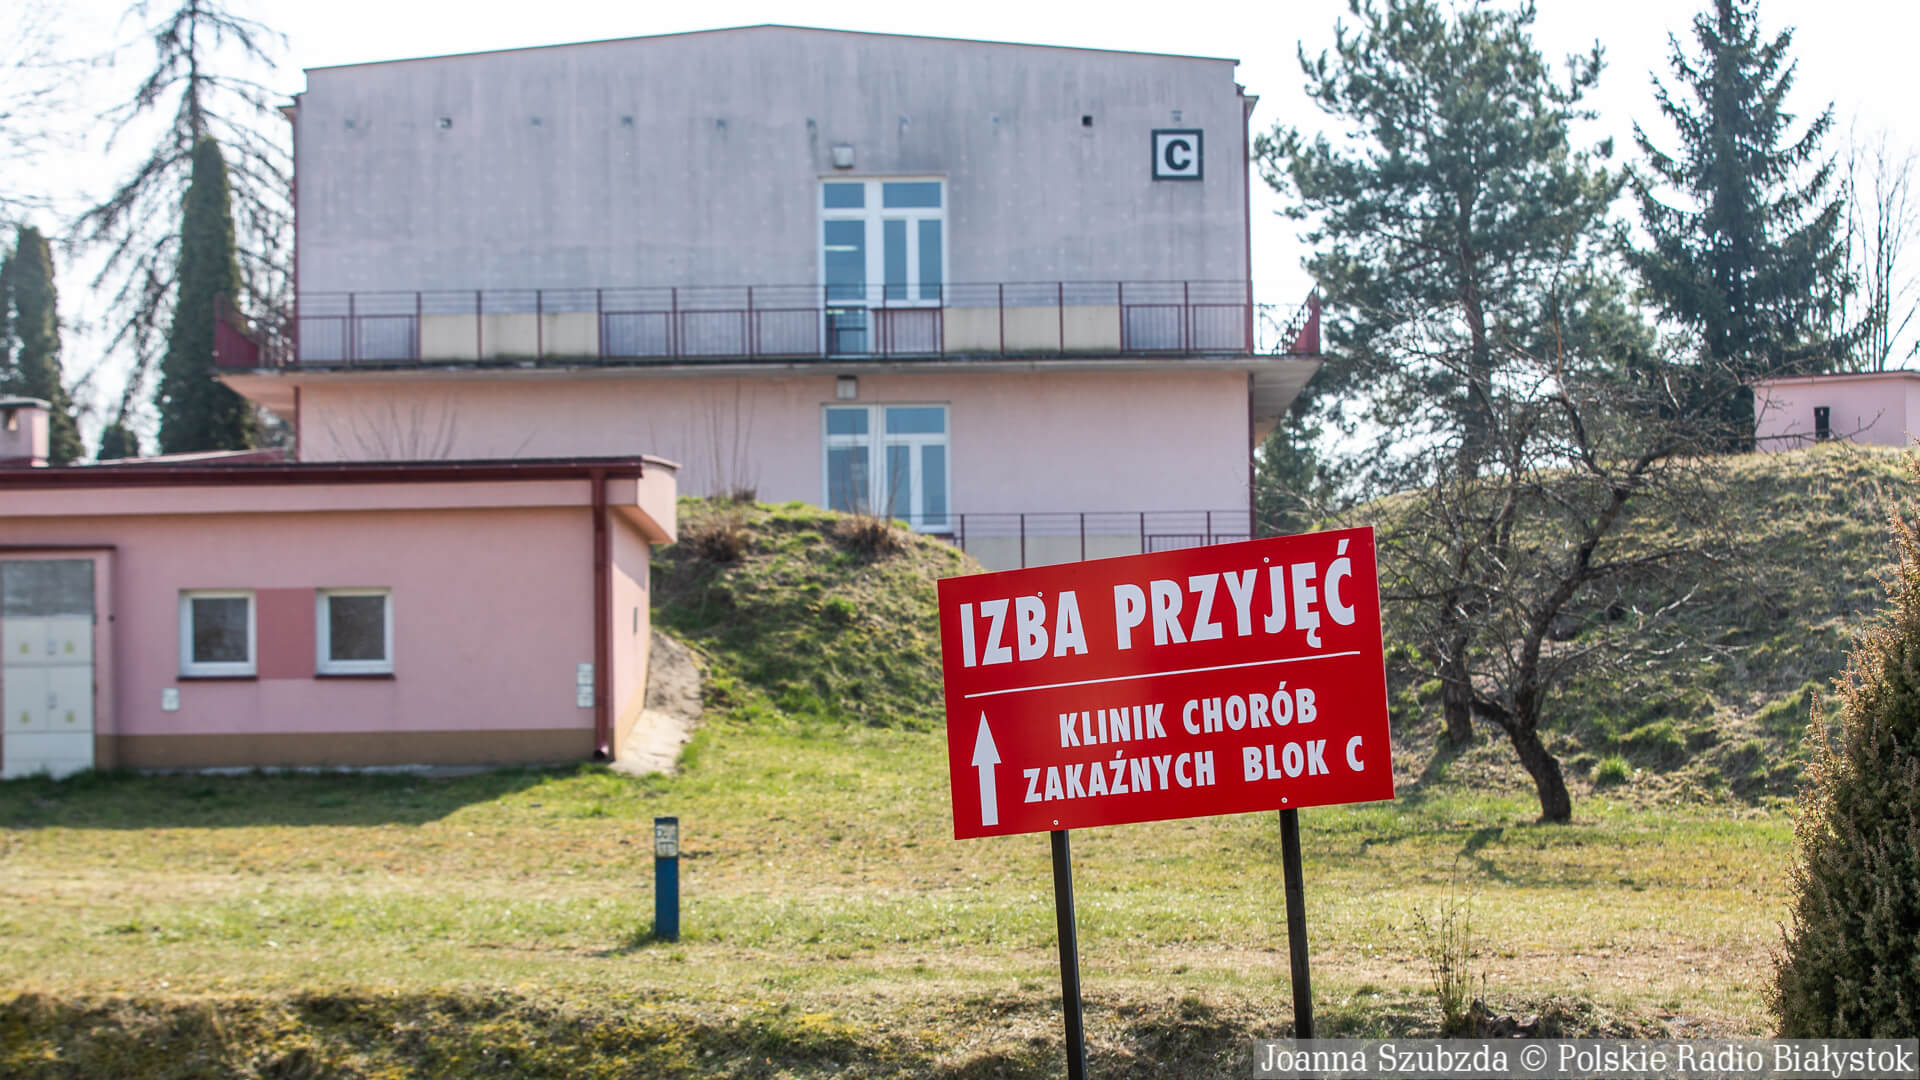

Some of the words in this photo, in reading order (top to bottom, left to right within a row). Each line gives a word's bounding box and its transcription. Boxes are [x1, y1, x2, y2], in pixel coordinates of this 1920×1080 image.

[1165, 138, 1191, 171] C
[959, 590, 1088, 668] IZBA
[1113, 538, 1356, 649] PRZYJĘĆ
[1058, 703, 1167, 748] KLINIK
[1182, 680, 1317, 735] CHORÓB
[1023, 749, 1216, 804] ZAKAŹNYCH
[1242, 739, 1330, 782] BLOK
[1345, 735, 1365, 772] C
